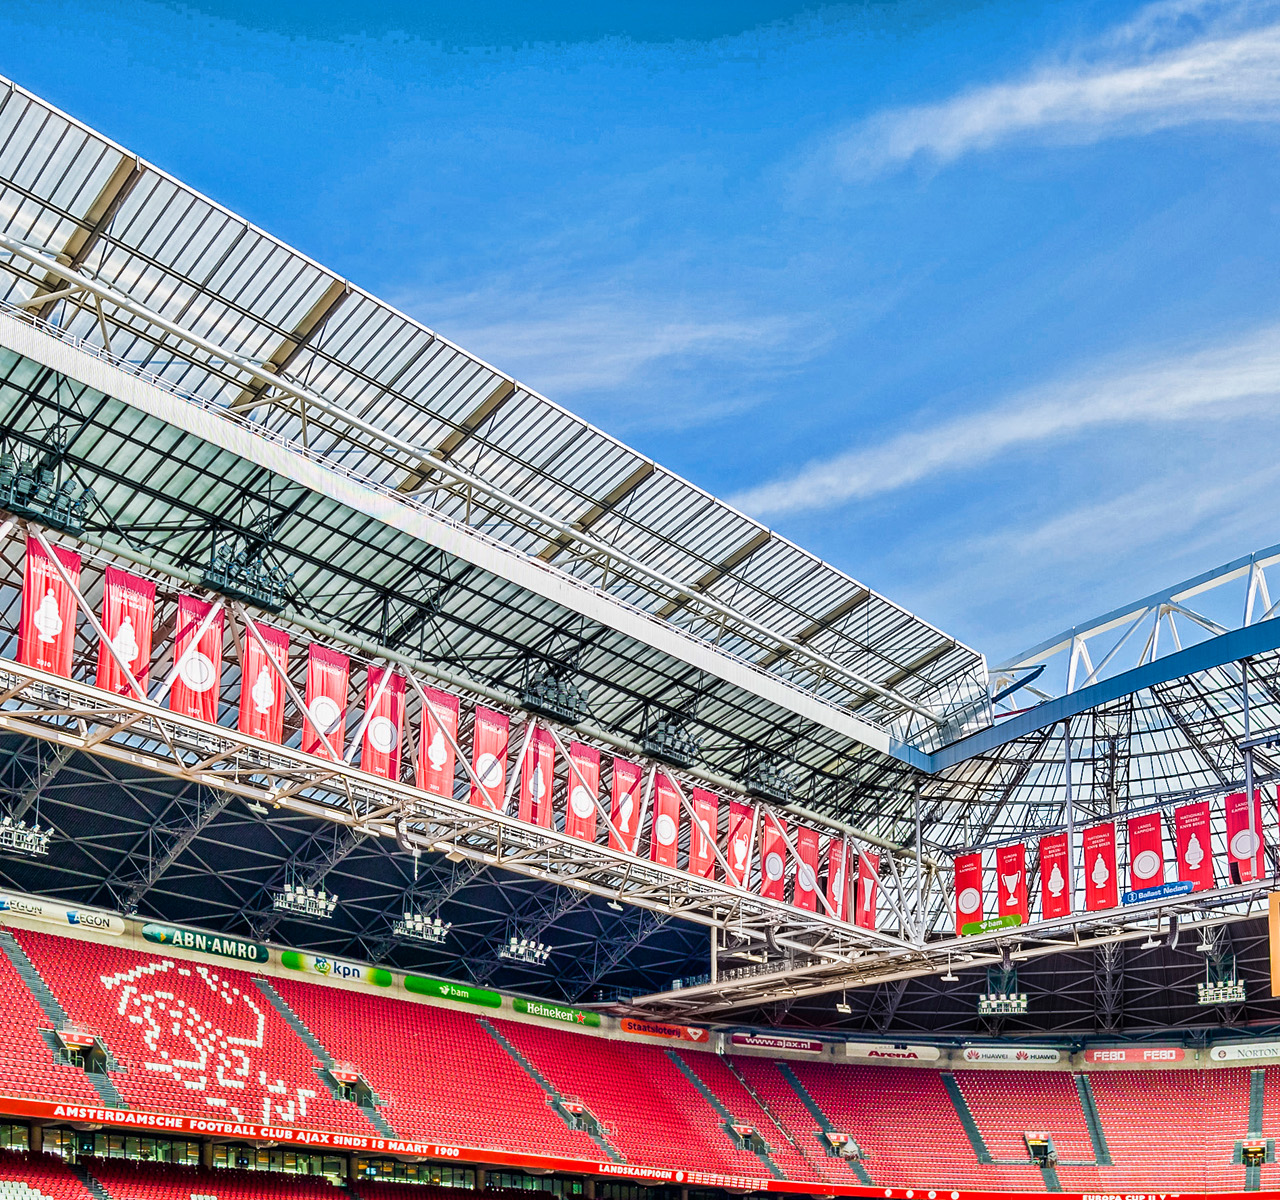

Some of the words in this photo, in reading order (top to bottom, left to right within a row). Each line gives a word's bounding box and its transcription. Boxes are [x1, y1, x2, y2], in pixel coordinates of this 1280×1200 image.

[1180, 811, 1205, 821] NATIONALE
[1138, 888, 1161, 899] Ballast
[1163, 884, 1189, 894] Nedam
[75, 913, 111, 929] AEGON
[988, 918, 1003, 927] bam
[332, 960, 361, 980] kpn
[450, 985, 470, 999] bam
[526, 1002, 574, 1023] Heineken
[626, 1021, 682, 1038] Staatsloterij
[745, 1037, 811, 1050] www.ajax.nl
[868, 1050, 919, 1059] ArenA
[1093, 1051, 1125, 1061] FEBO
[1143, 1050, 1176, 1061] FEBO
[1237, 1047, 1279, 1059] NORTON
[54, 1105, 182, 1129] AMSTERDAMSCHE
[189, 1120, 256, 1136] FOOTBALL
[260, 1127, 293, 1139] CLUB
[296, 1131, 329, 1145] AJAX
[333, 1135, 367, 1148] SINDS
[371, 1139, 384, 1149] 18
[388, 1141, 428, 1154] MAART
[434, 1146, 460, 1157] 1900
[599, 1164, 672, 1179] LANDSKAMPIOEN
